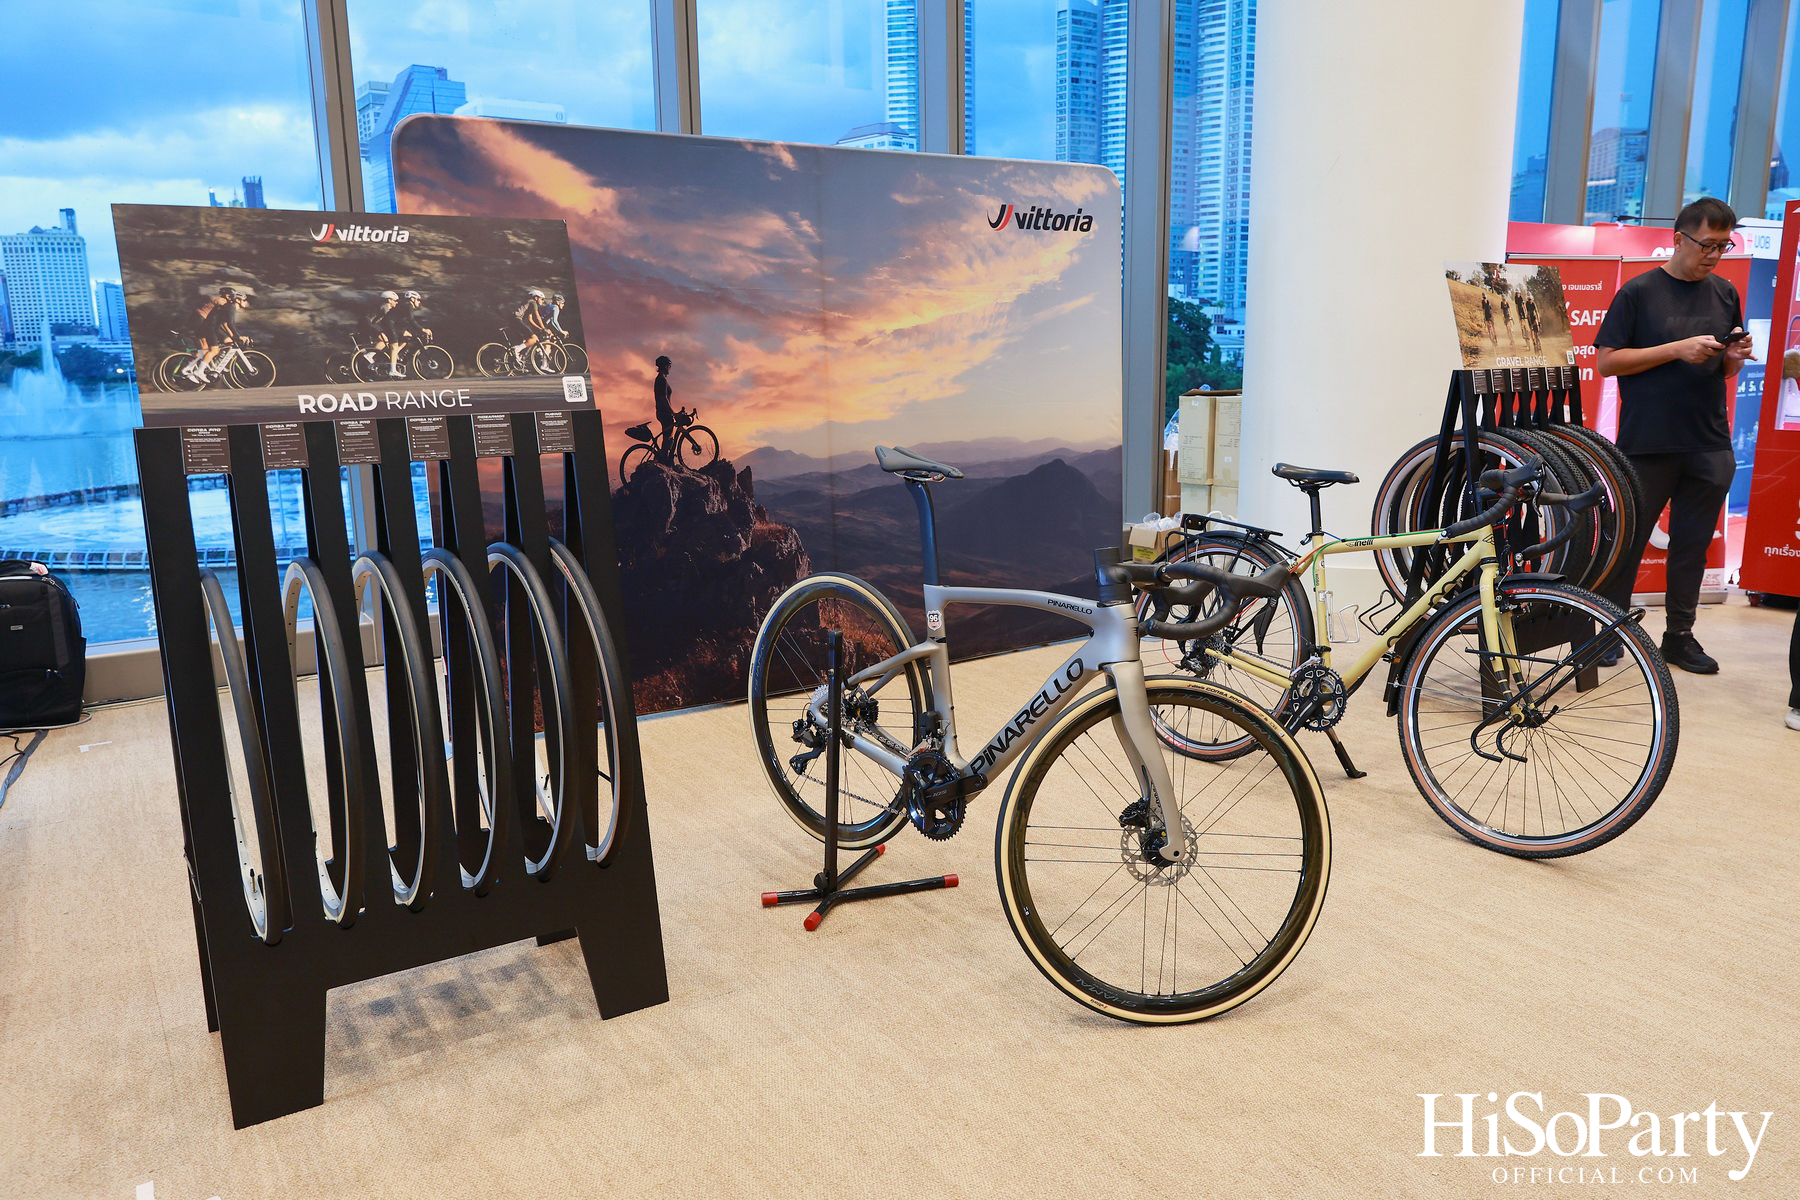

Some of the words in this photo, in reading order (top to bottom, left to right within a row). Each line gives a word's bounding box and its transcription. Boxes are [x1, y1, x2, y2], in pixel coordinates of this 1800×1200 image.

[1014, 205, 1093, 232] vittoria
[335, 224, 410, 243] vittoria
[1754, 234, 1771, 249] UOB
[1496, 356, 1524, 367] GRAVEL
[1524, 355, 1548, 367] RANGE
[298, 392, 378, 414] ROAD
[384, 389, 473, 410] RANGE
[1047, 599, 1093, 615] PINARELLO
[929, 614, 939, 623] 96
[970, 657, 1084, 775] PINARELLO
